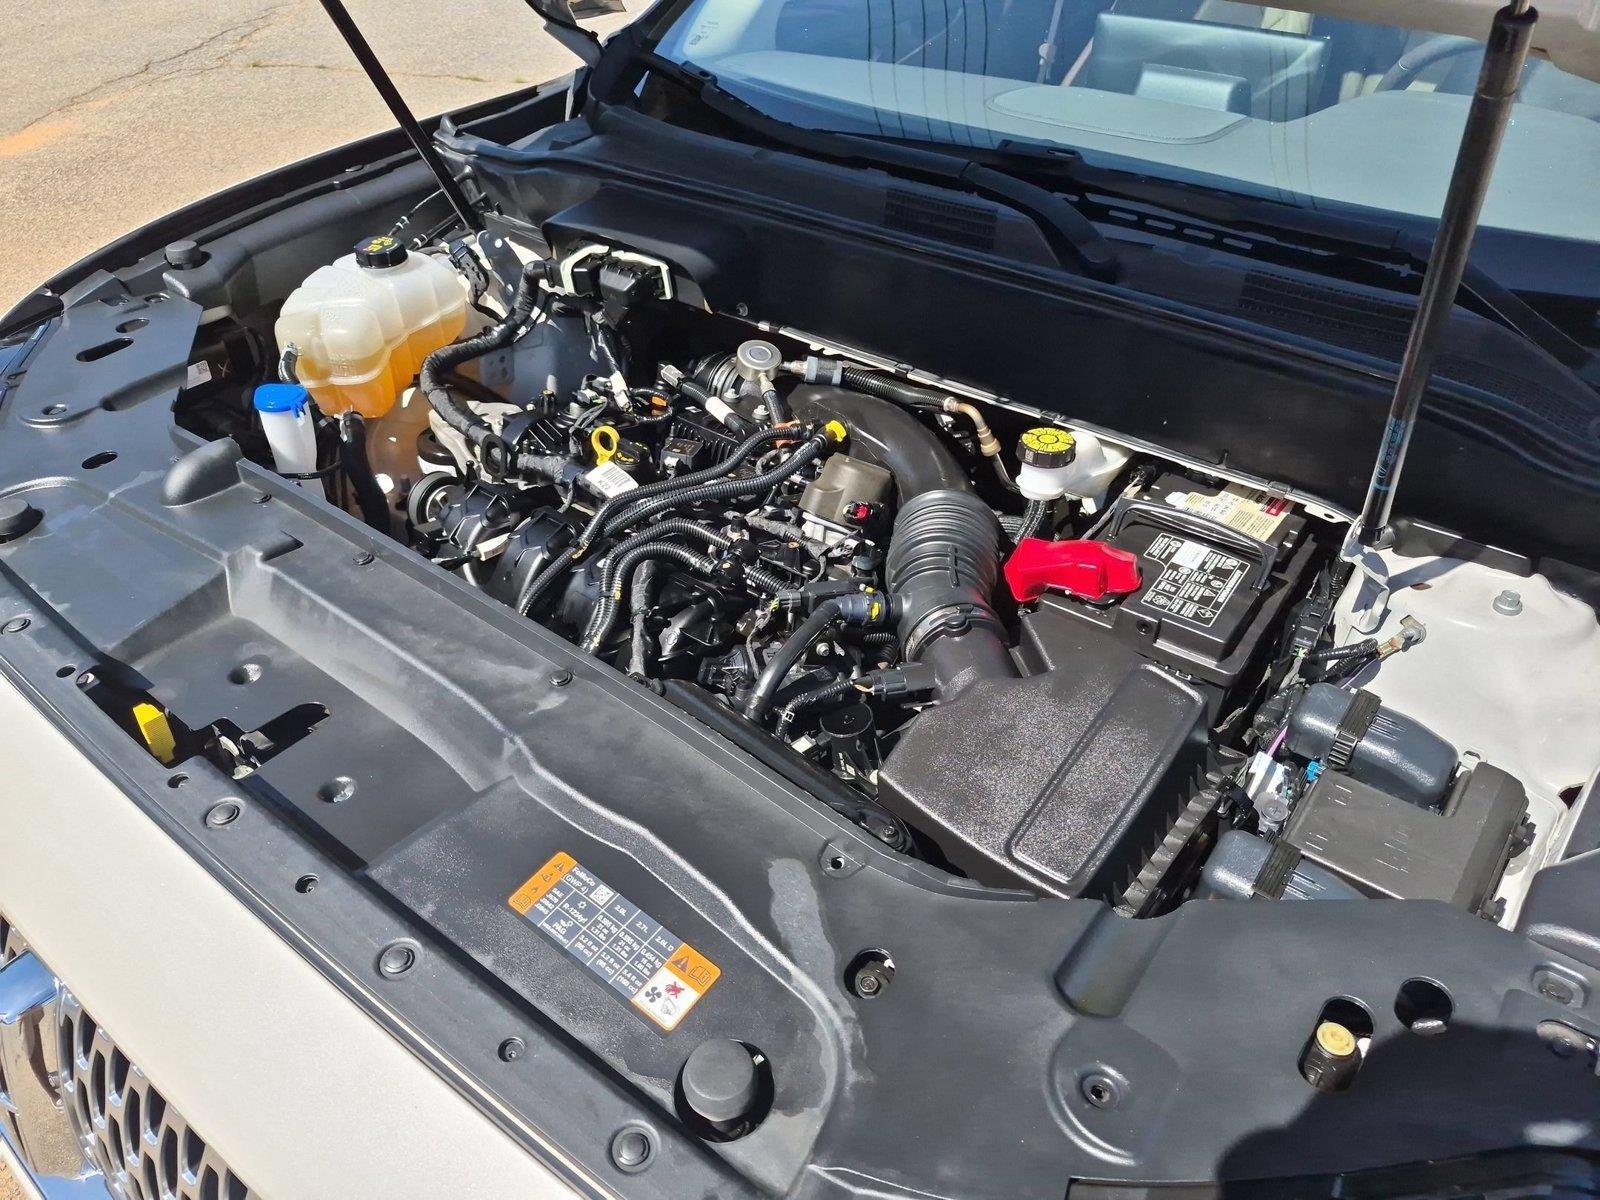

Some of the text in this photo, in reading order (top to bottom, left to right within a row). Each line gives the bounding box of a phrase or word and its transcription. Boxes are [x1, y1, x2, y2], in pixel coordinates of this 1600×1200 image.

[562, 873, 581, 889] (GWP
[571, 867, 596, 886] FoMoCo
[561, 903, 587, 924] R-1234yf
[552, 922, 566, 934] PAG
[635, 921, 649, 933] 2.7L
